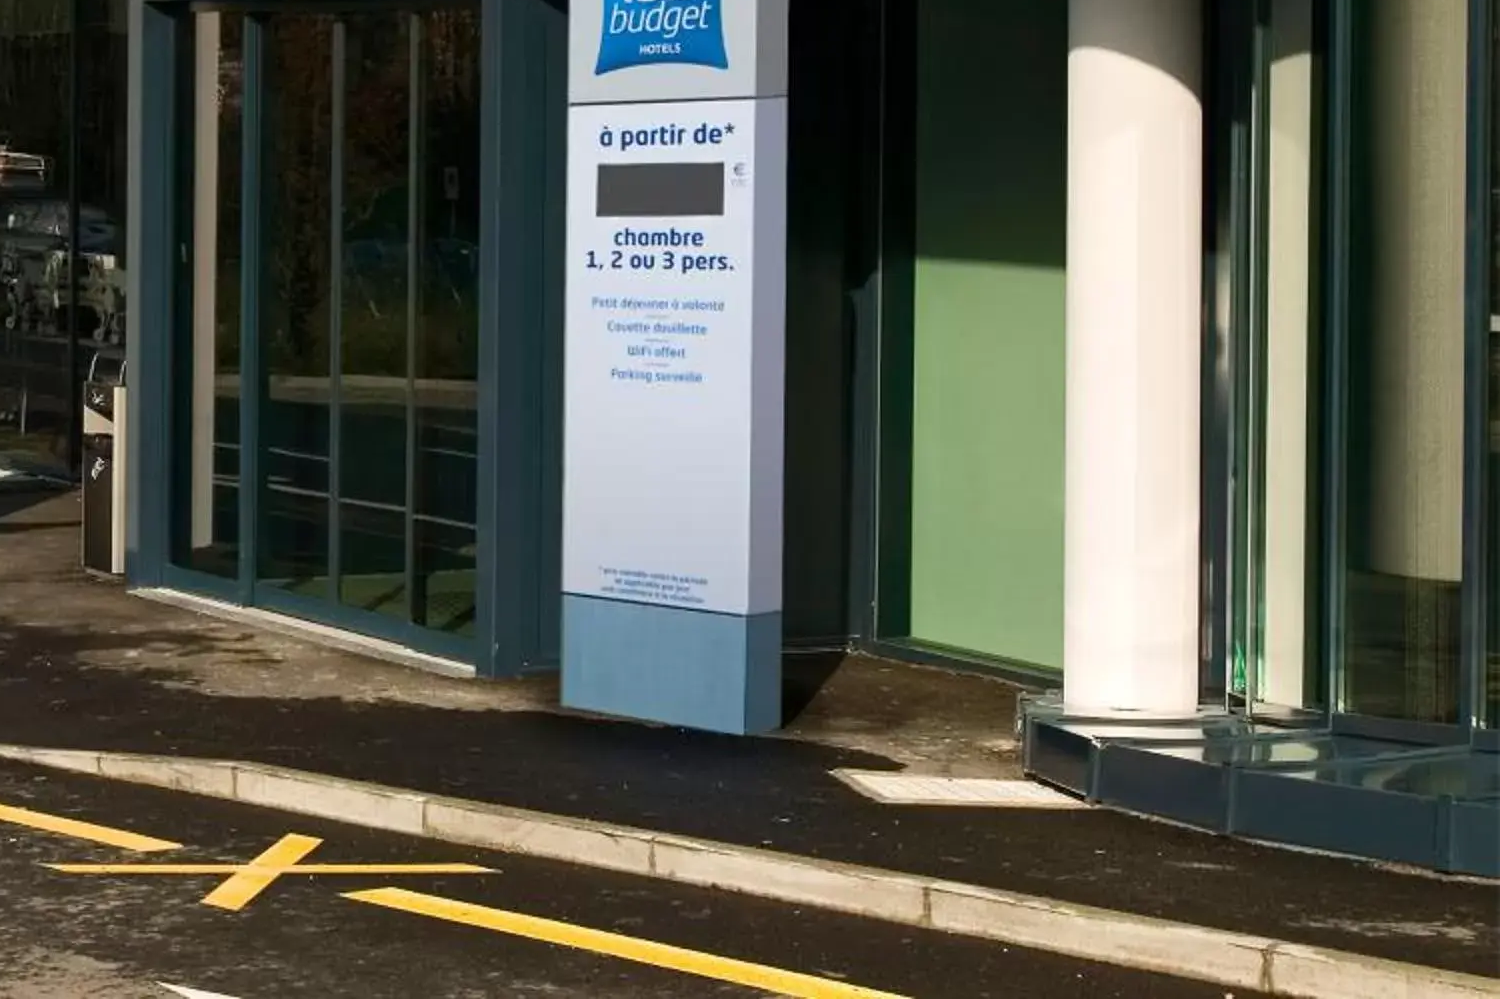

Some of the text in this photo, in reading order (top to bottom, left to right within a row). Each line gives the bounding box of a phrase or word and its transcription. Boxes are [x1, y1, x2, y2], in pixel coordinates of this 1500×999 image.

[610, 1, 712, 38] budget
[639, 43, 681, 54] HOTELS
[600, 126, 613, 147] à
[621, 123, 686, 151] partir
[613, 227, 704, 247] chambre
[586, 250, 735, 274] 1, 2 ou 3 pers.
[591, 296, 618, 309] Petit
